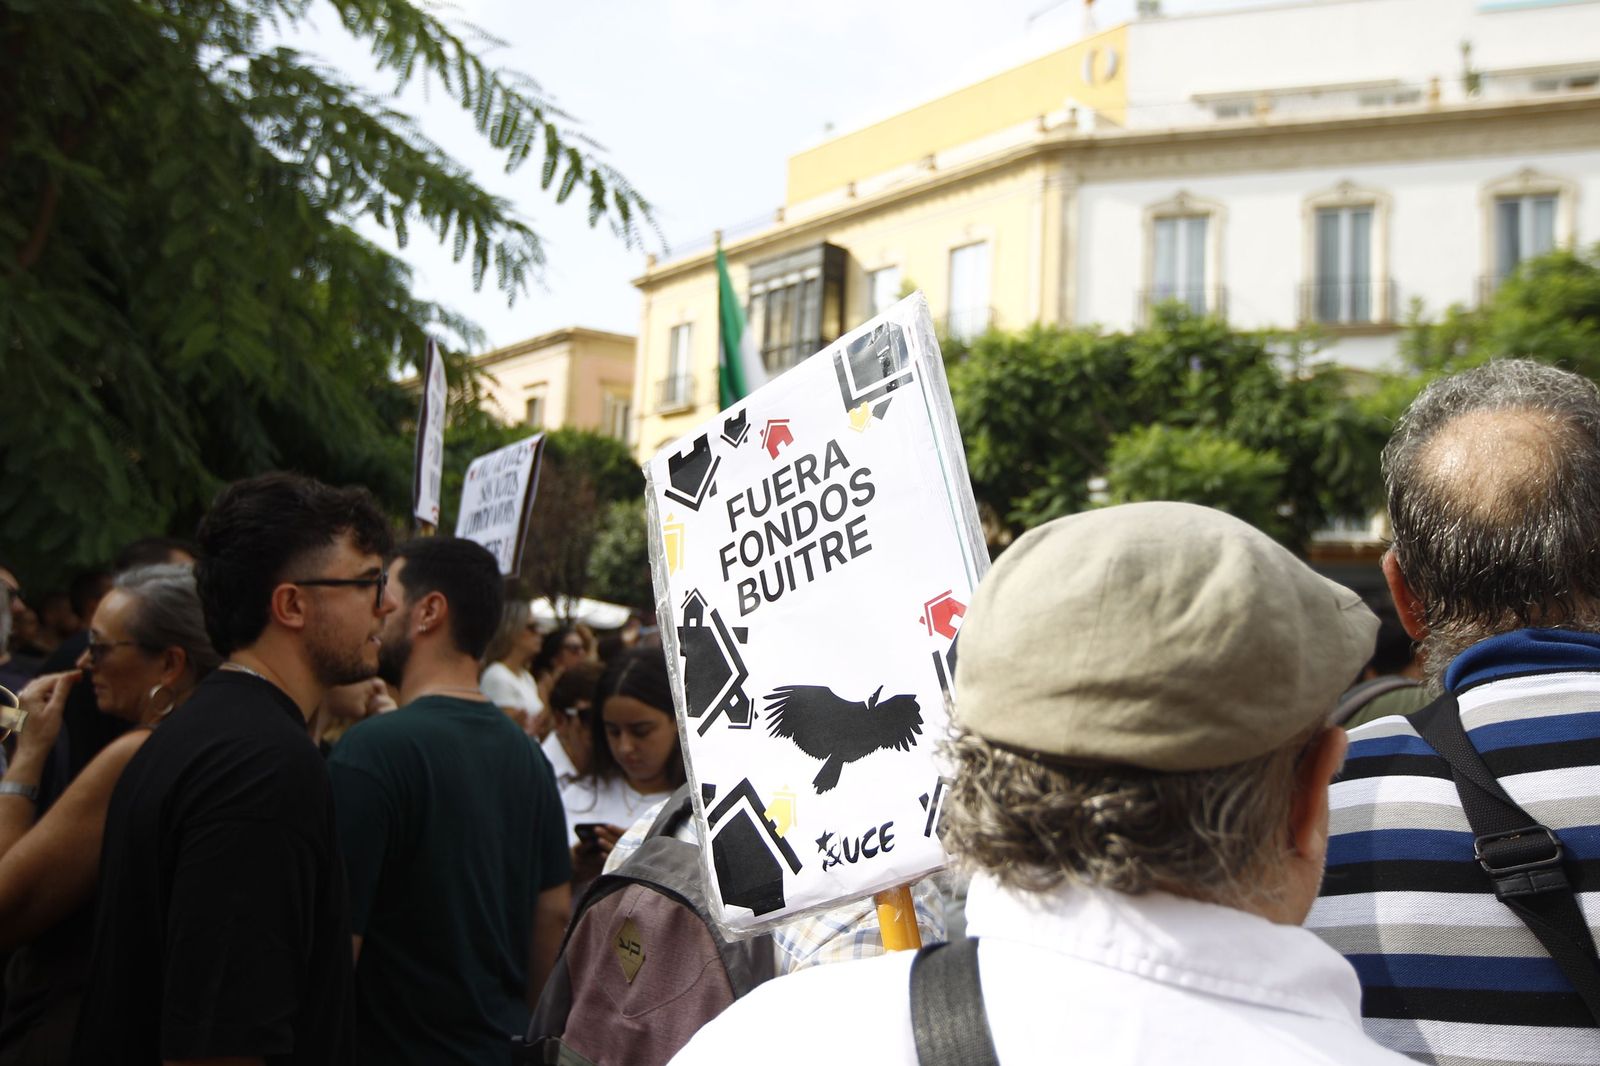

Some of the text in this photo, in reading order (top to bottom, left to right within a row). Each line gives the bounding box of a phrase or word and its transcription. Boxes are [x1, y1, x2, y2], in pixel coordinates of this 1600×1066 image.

[719, 467, 876, 582] FONDOS
[726, 439, 850, 532] FUERA
[737, 514, 873, 617] BUITRE
